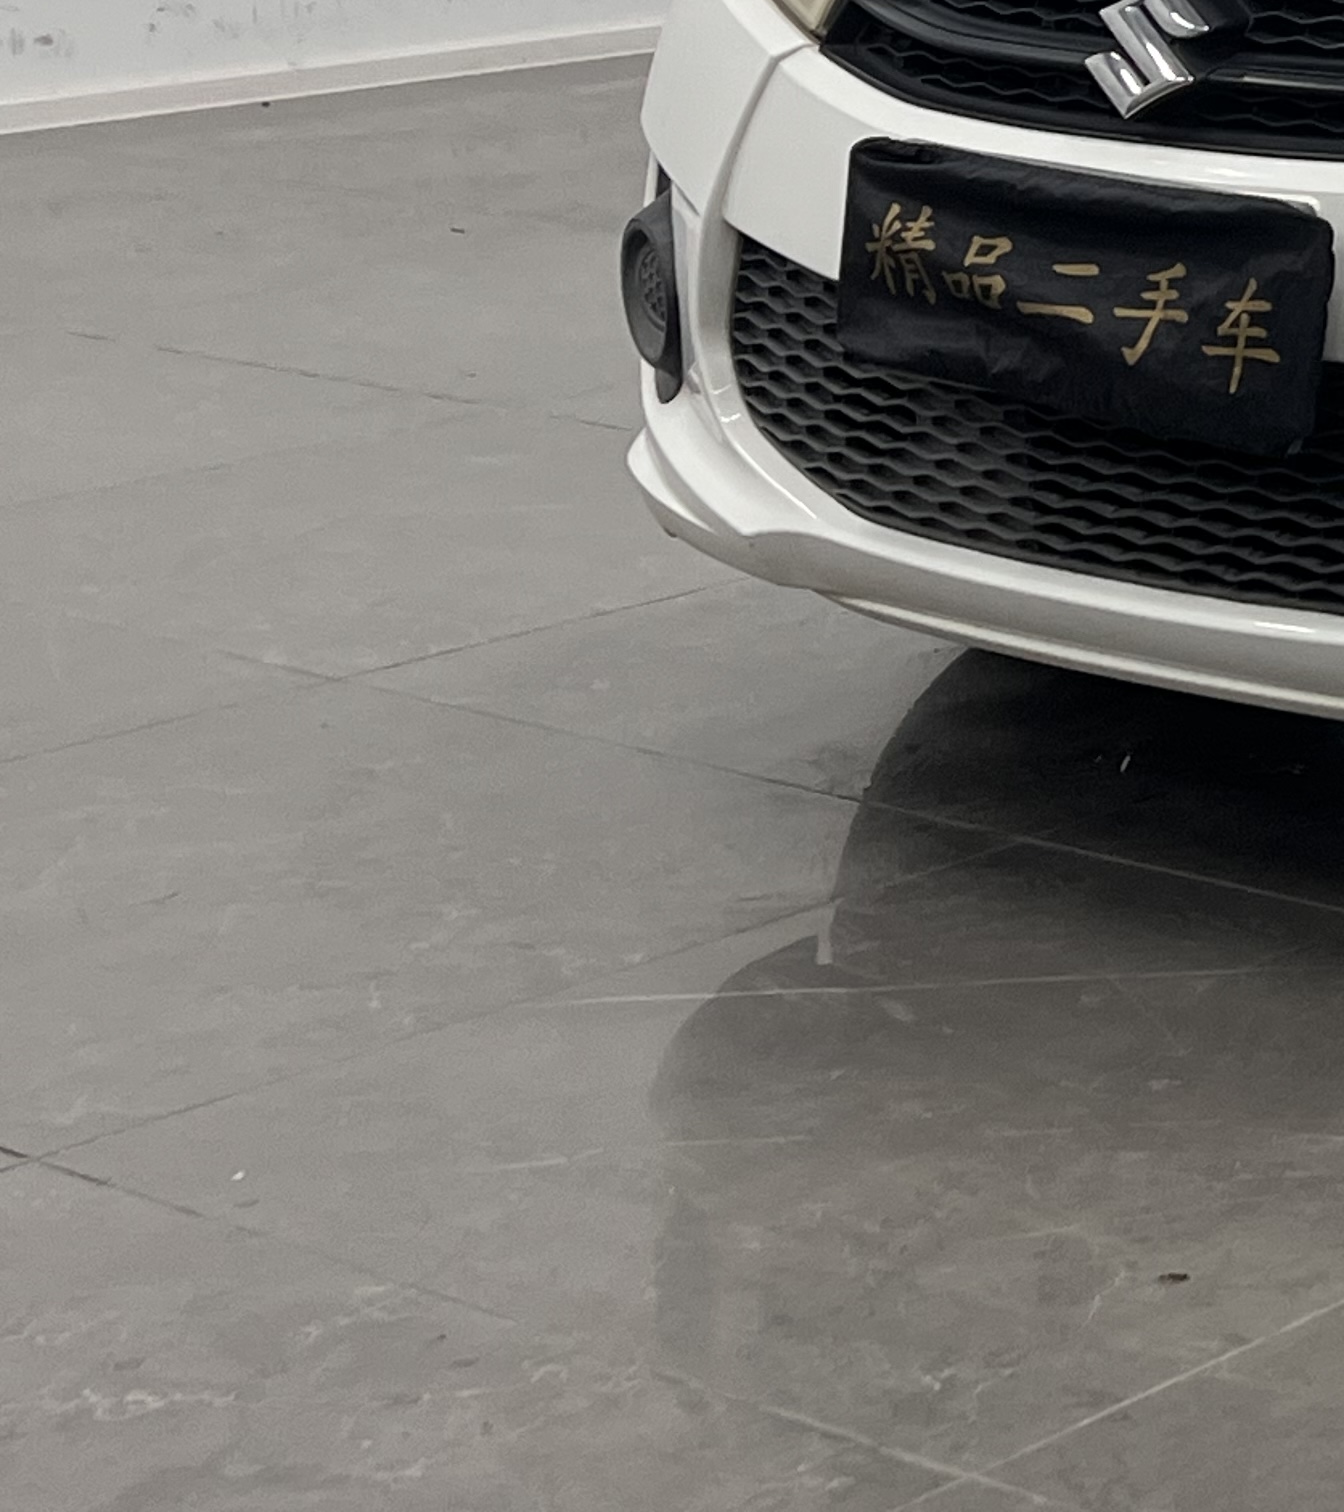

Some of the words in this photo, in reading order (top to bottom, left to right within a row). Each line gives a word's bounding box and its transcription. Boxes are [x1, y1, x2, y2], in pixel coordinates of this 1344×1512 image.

[865, 201, 1281, 395] 精品二手车
